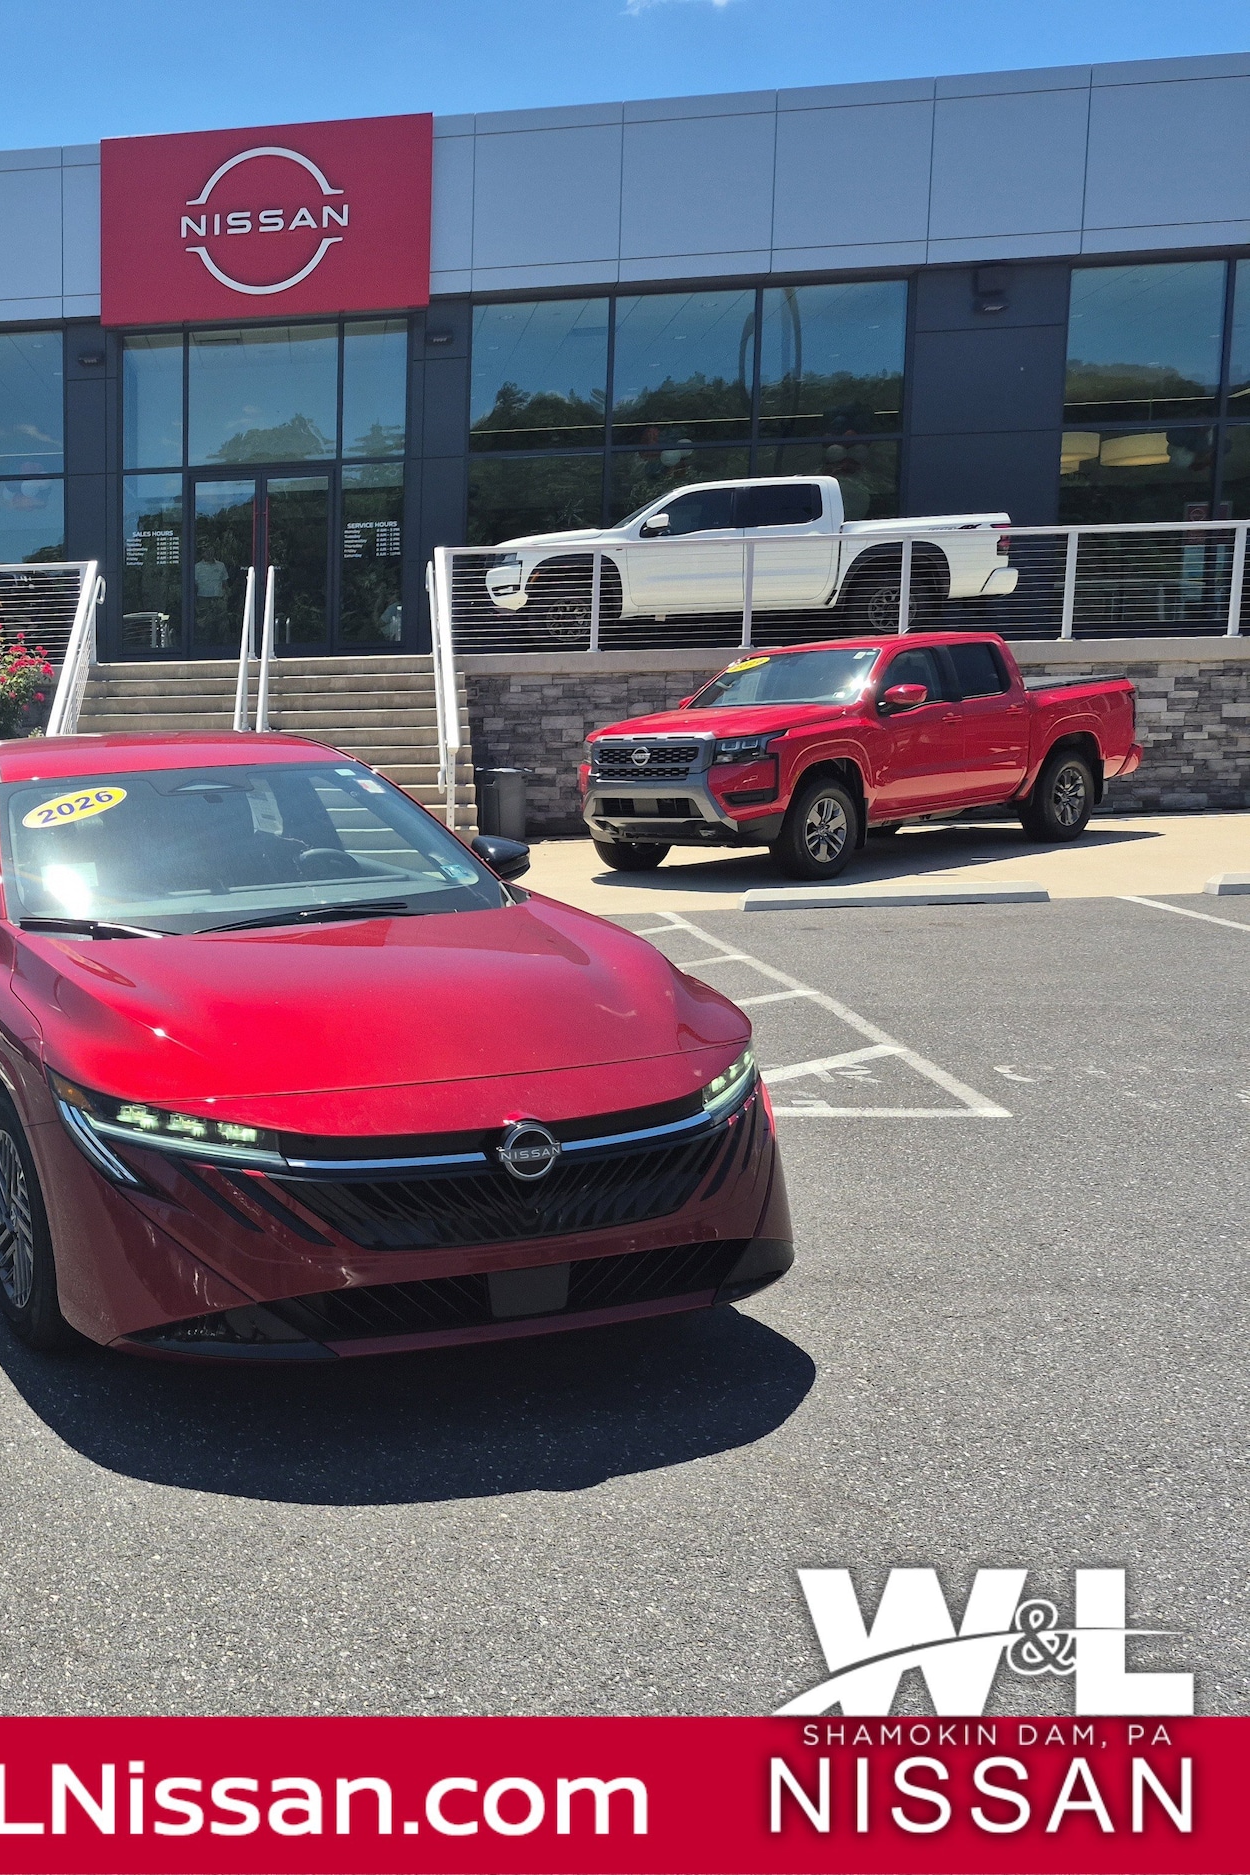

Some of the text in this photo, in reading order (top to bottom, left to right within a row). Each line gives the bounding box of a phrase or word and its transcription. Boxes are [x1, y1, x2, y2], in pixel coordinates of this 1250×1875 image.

[180, 203, 349, 239] NISSAN
[374, 520, 398, 528] HOURS
[36, 790, 114, 825] 2026
[500, 1145, 560, 1160] NISSAN
